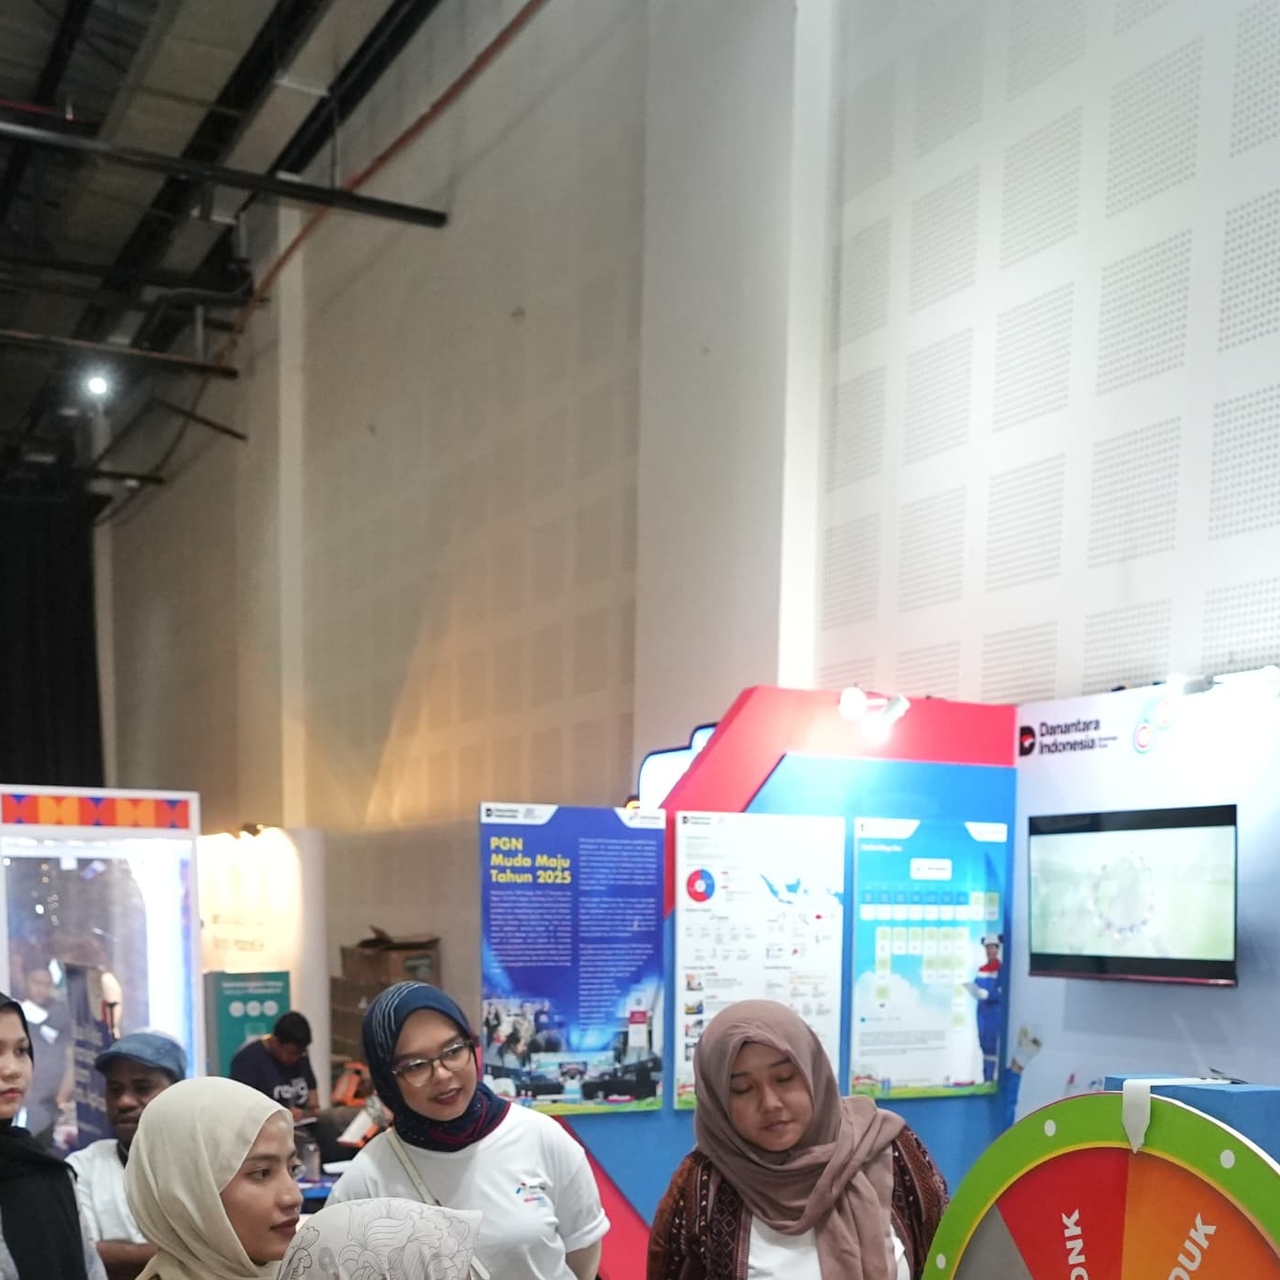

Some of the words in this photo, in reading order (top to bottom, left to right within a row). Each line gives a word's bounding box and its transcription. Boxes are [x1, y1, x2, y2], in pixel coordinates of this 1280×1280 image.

[1039, 718, 1101, 737] Danantara
[1039, 736, 1096, 754] Indonesia
[490, 836, 523, 851] PGN
[490, 853, 532, 867] Muda
[535, 853, 571, 871] Maju
[490, 868, 533, 883] Tahun
[536, 870, 571, 884] 2025
